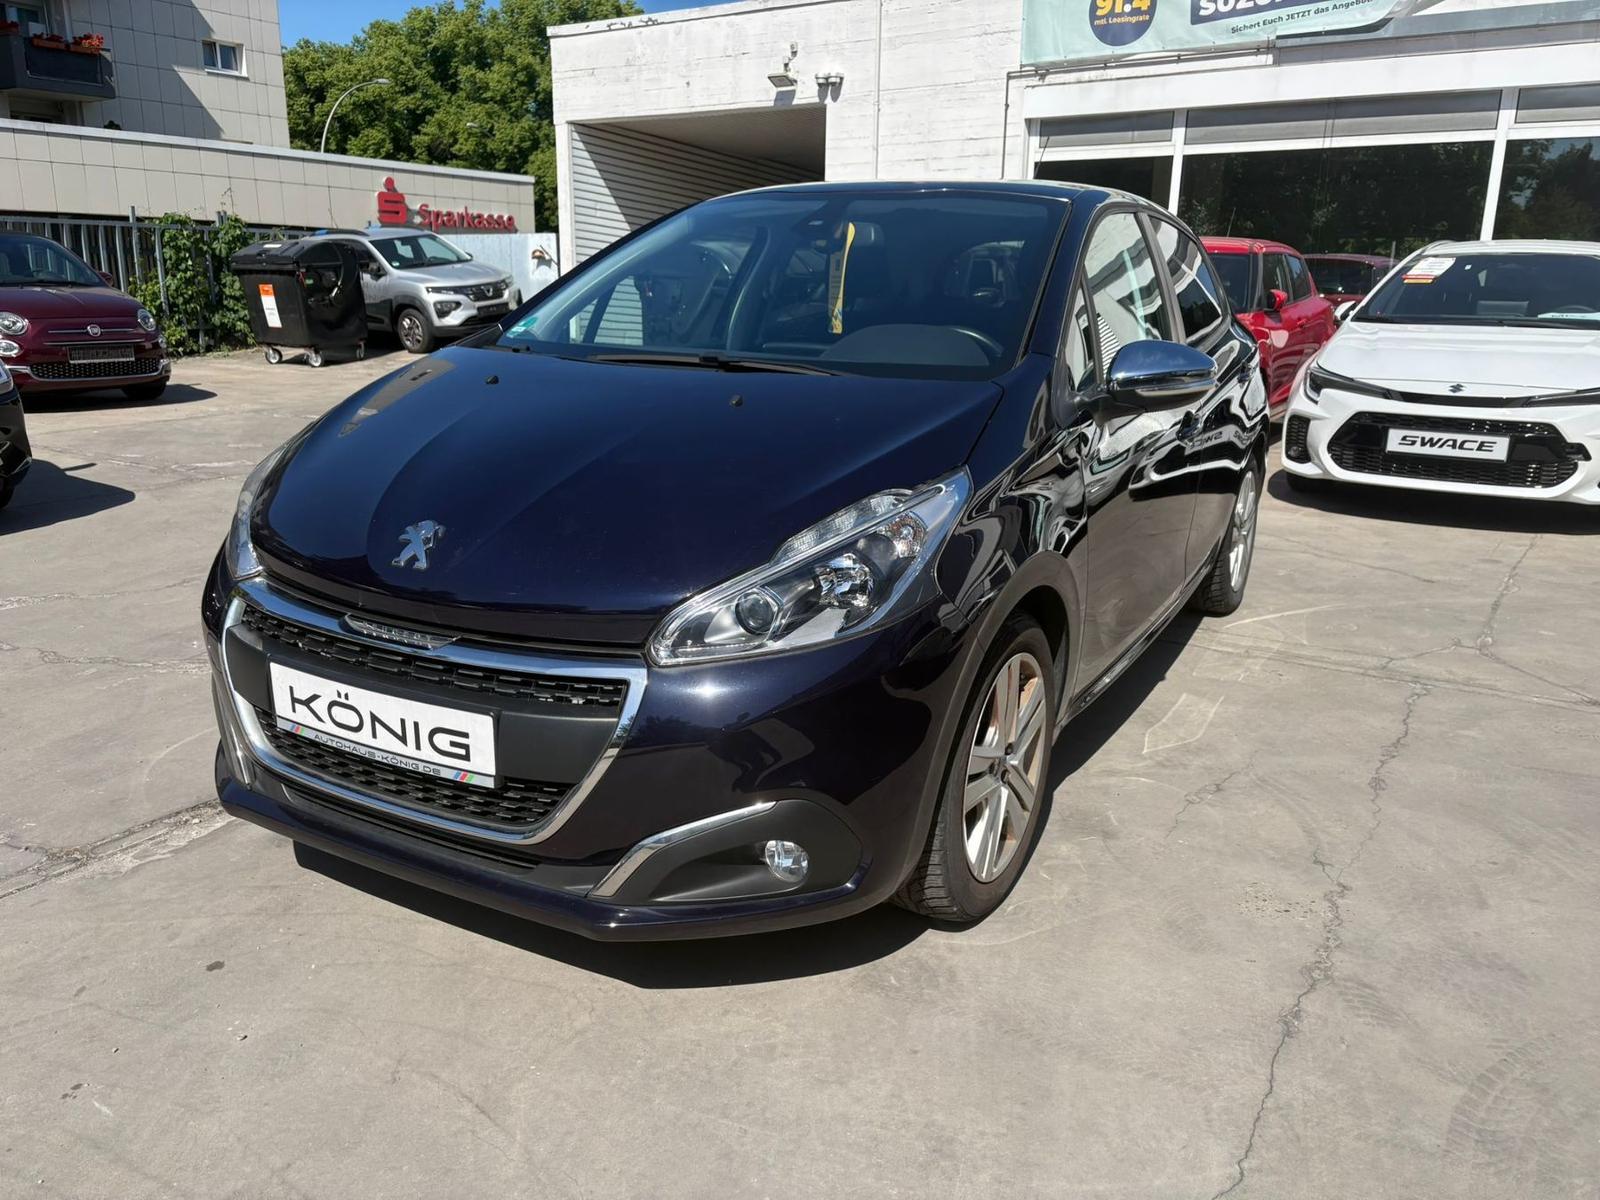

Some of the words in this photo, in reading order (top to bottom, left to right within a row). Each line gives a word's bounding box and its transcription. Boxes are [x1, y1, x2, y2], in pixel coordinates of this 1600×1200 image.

[1231, 22, 1260, 34] Sichert
[1263, 16, 1284, 26] Euch
[1286, 9, 1312, 21] JETZT
[1314, 6, 1330, 15] das
[418, 203, 516, 231] Sparkasse
[1398, 435, 1498, 453] SWACE
[289, 685, 472, 762] KÖNIG
[314, 733, 441, 775] AUTOHAUS-KÖNIGDE
